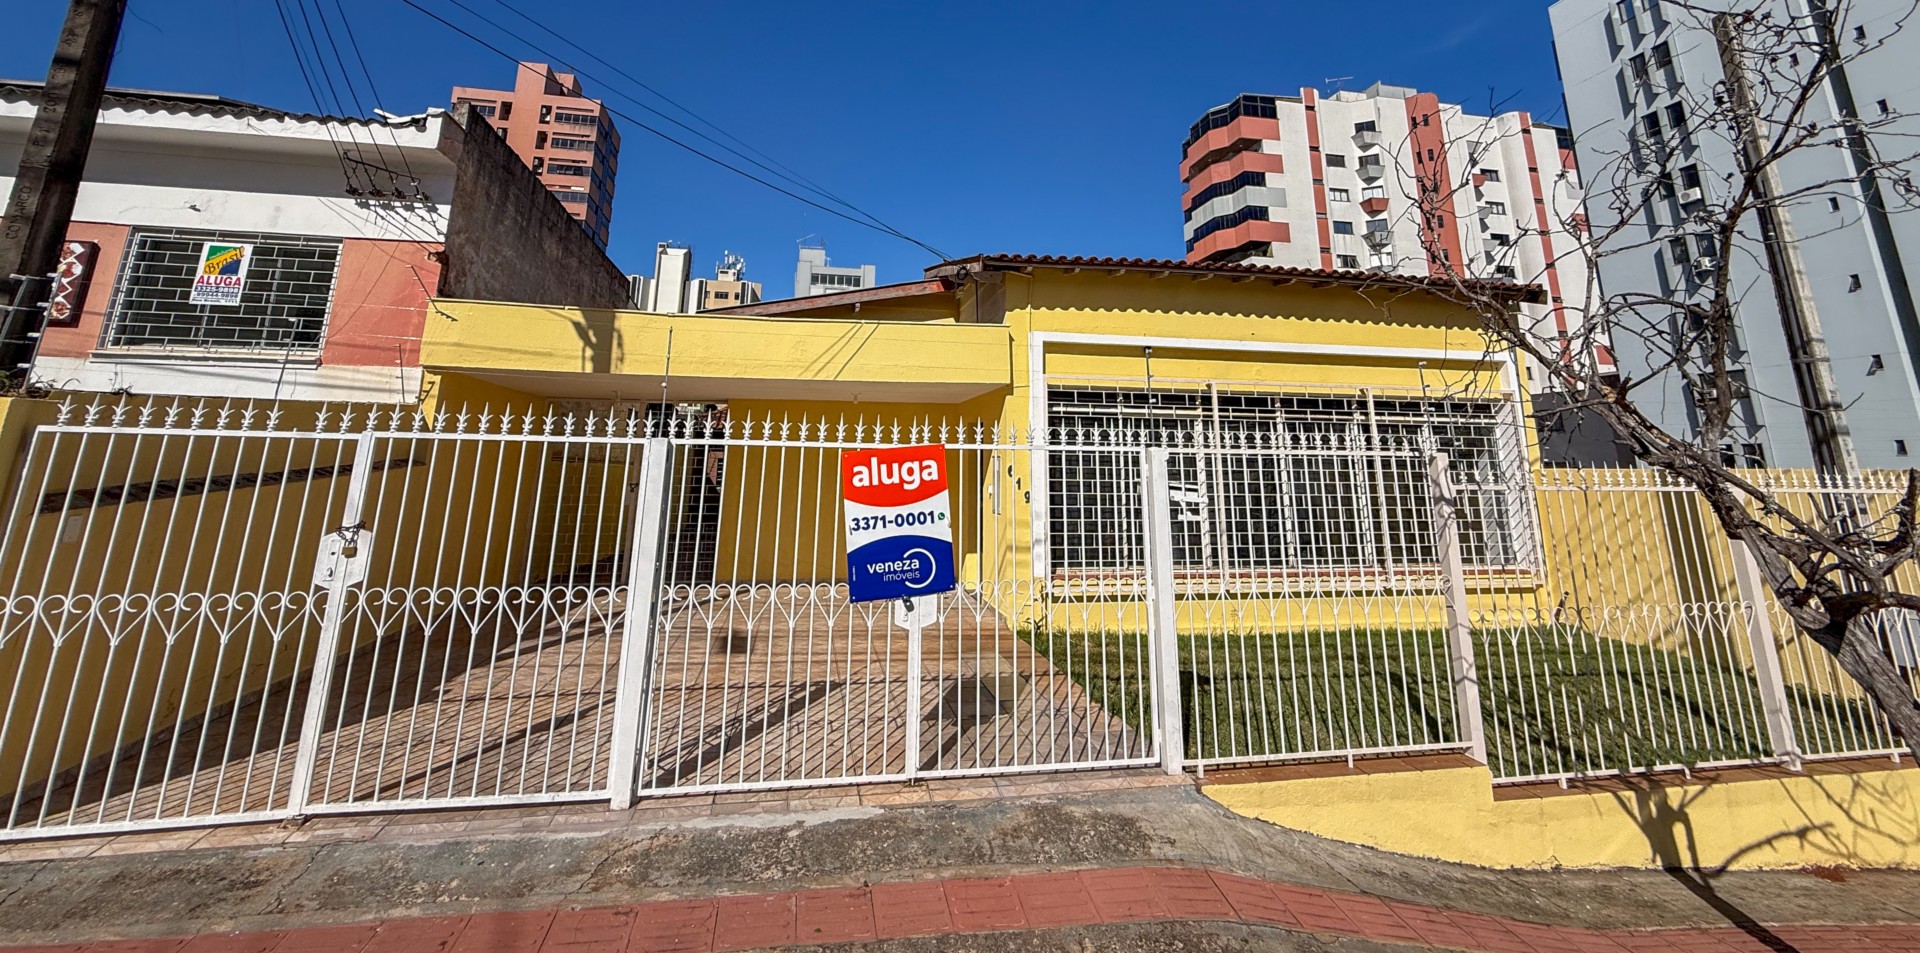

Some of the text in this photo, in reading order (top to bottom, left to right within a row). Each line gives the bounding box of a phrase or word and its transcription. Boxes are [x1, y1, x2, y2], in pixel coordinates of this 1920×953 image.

[6, 186, 32, 240] COMARCO
[204, 246, 245, 274] Brasil
[196, 275, 241, 286] ALUGA
[196, 285, 239, 293] 3325-9898
[852, 457, 939, 490] aluga
[851, 511, 935, 531] 3371-0001
[867, 558, 920, 574] veneza
[883, 570, 921, 582] imóveis
